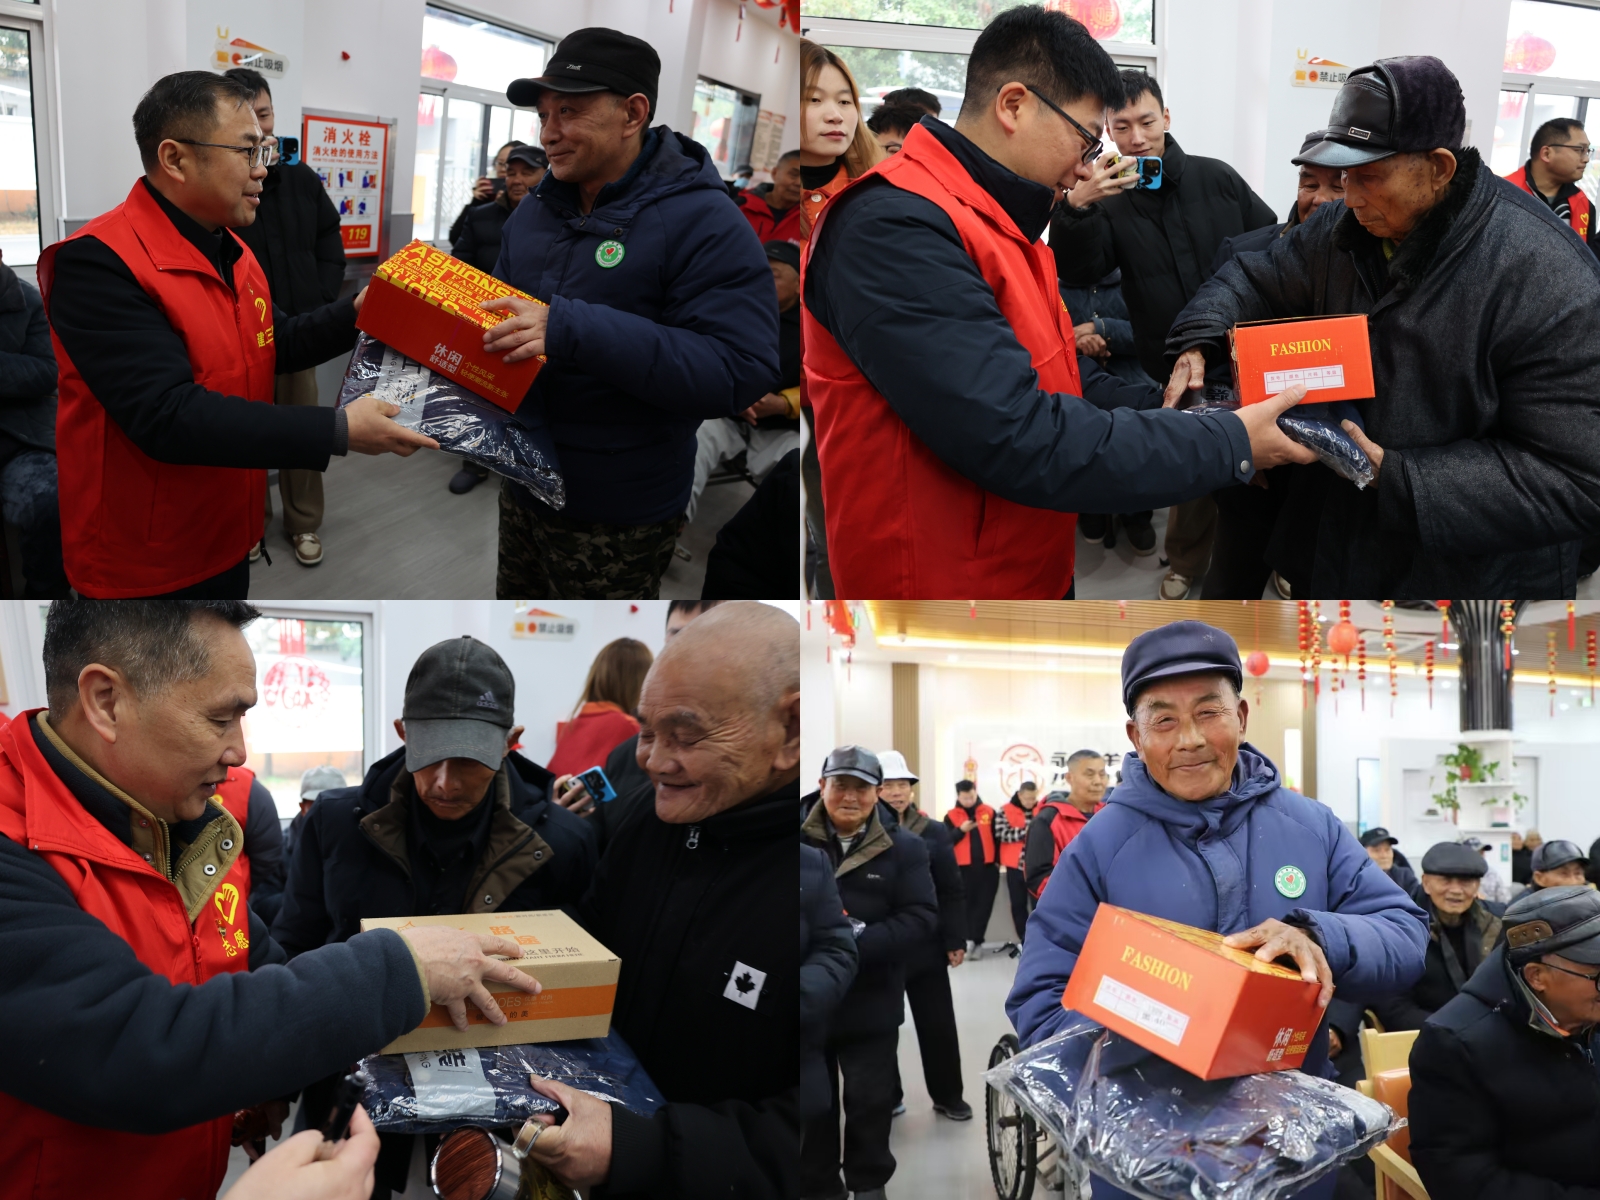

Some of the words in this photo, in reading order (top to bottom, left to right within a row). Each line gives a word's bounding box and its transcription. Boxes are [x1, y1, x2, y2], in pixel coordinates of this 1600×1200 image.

[1319, 71, 1348, 83] 禁止吸
[323, 126, 371, 147] 消火栓
[312, 145, 378, 160] 消火栓的使用方法
[348, 227, 368, 240] 119
[419, 278, 457, 303] WORKS
[434, 343, 463, 366] 休闲
[1270, 338, 1332, 357] FASHION
[429, 354, 458, 374] 舒适型
[1120, 944, 1194, 992] FASHION
